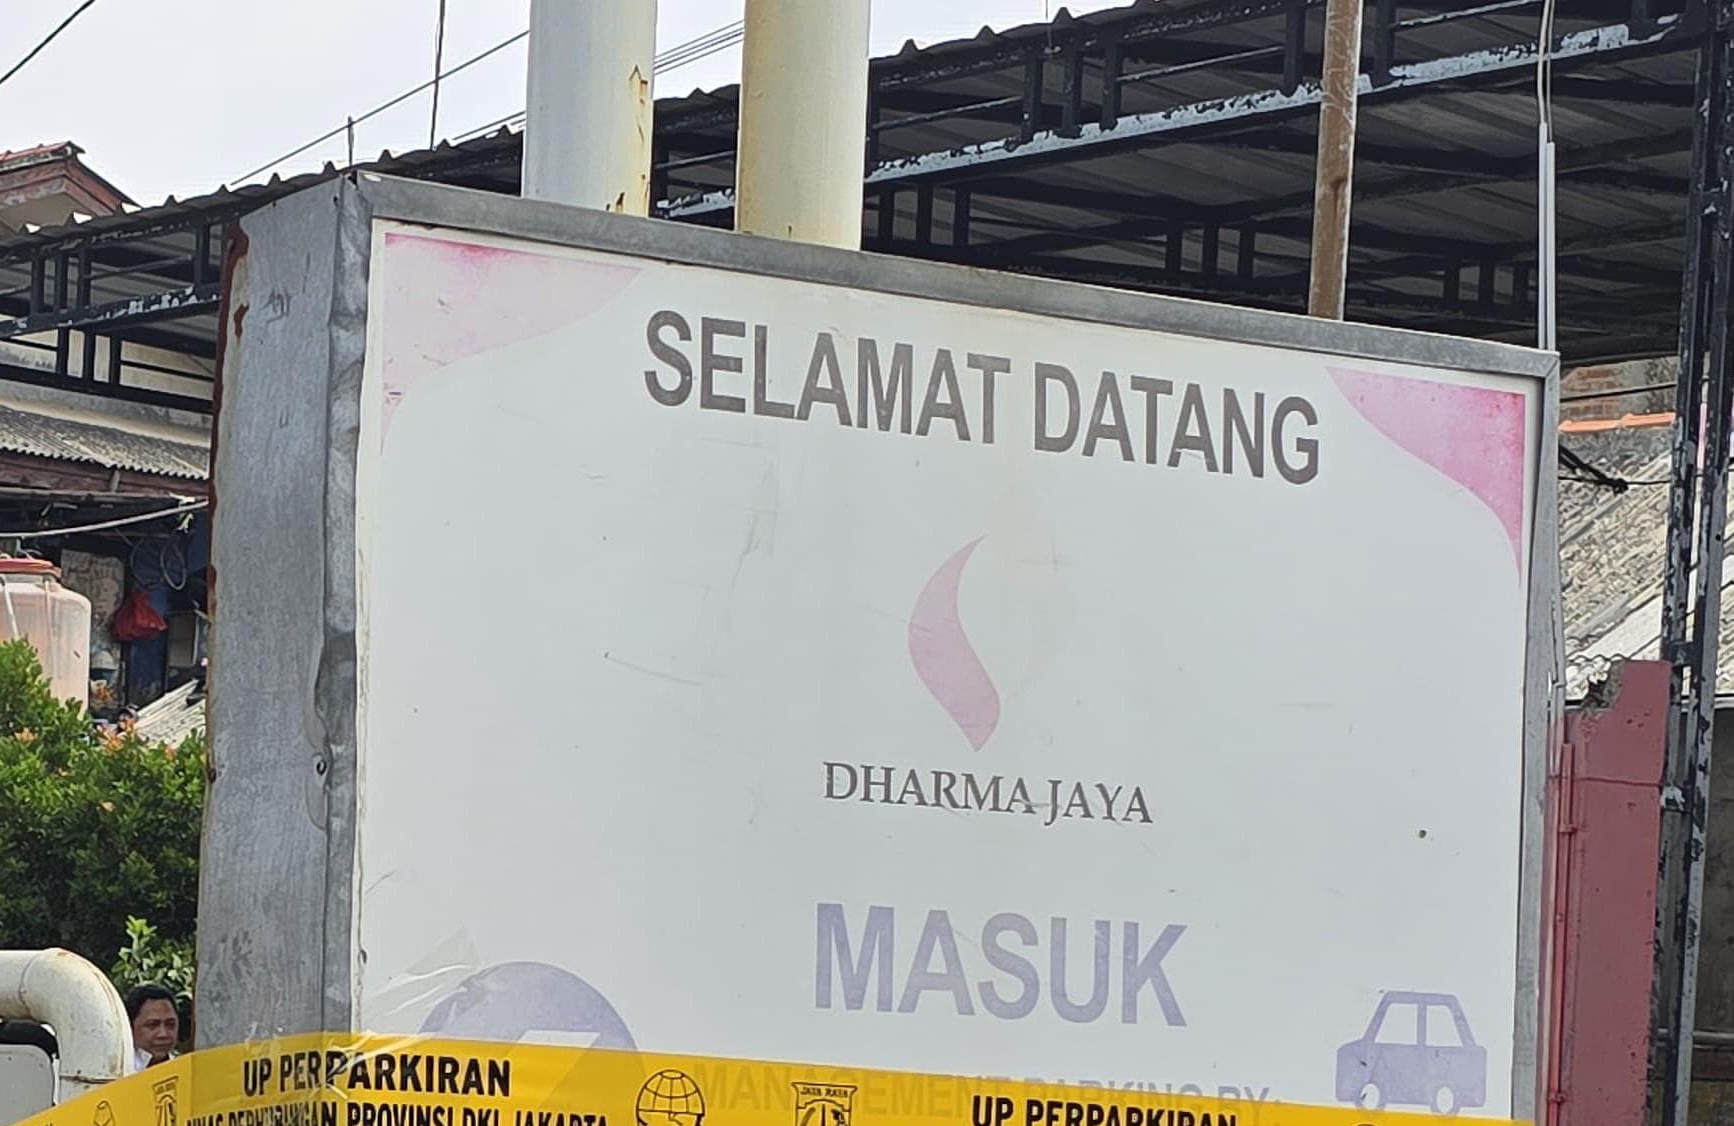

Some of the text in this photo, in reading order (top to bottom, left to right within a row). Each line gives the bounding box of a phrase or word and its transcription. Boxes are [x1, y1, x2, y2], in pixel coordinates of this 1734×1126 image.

[644, 309, 1320, 485] SELAMAT DATANG
[823, 761, 1153, 826] DHARMA JAYA
[816, 902, 1188, 1028] MASUK
[244, 1050, 511, 1098] UP PERPARKIRAN
